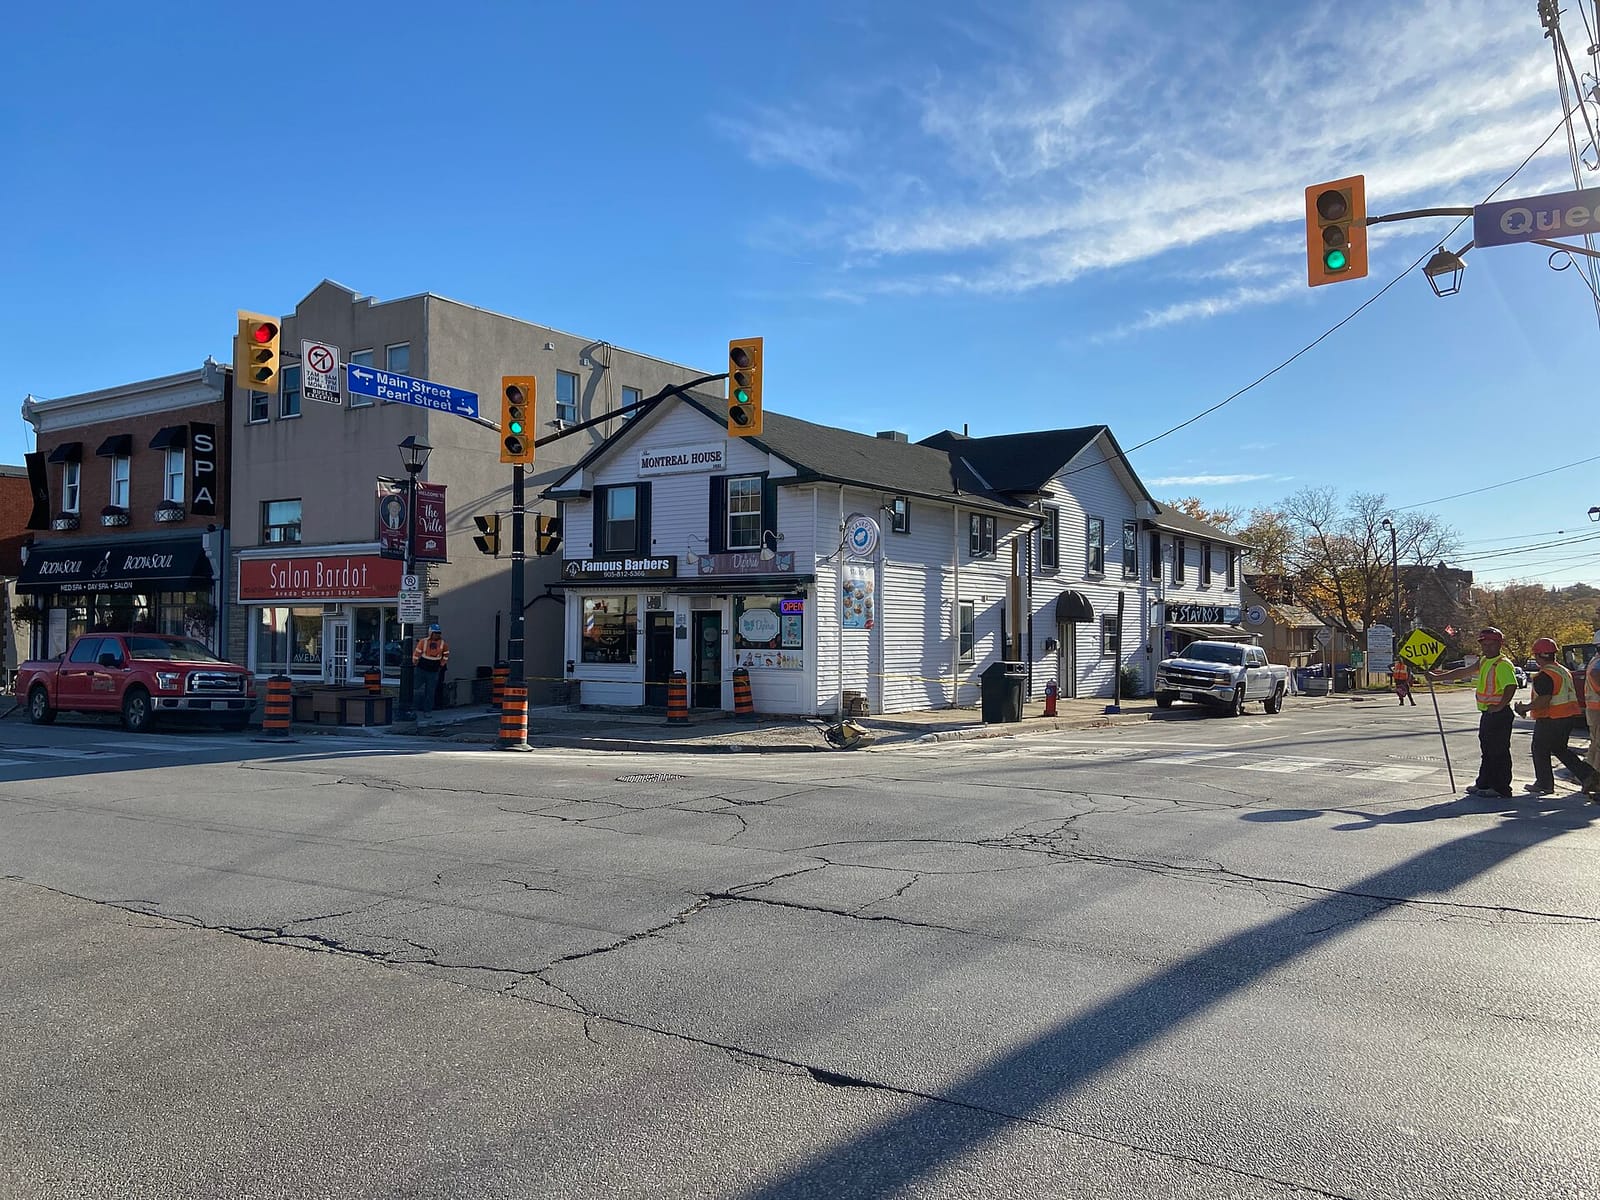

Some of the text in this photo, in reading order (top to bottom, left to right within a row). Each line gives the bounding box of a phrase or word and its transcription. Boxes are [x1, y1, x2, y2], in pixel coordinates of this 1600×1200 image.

[1500, 206, 1600, 235] Que
[376, 372, 451, 399] Main Street
[377, 385, 452, 411] Pearl Street
[641, 450, 722, 469] MONTREAL HOUSE
[194, 434, 214, 504] SPA
[419, 516, 444, 532] Ville
[270, 559, 367, 589] Salon Bardot
[581, 558, 669, 572] Famous Barbers
[98, 582, 110, 590] SPA
[114, 581, 133, 590] SALON
[783, 602, 803, 611] OPEN
[1179, 605, 1220, 623] STAVRO'S
[293, 653, 321, 662] AVEDA
[1405, 641, 1439, 659] SLOW
